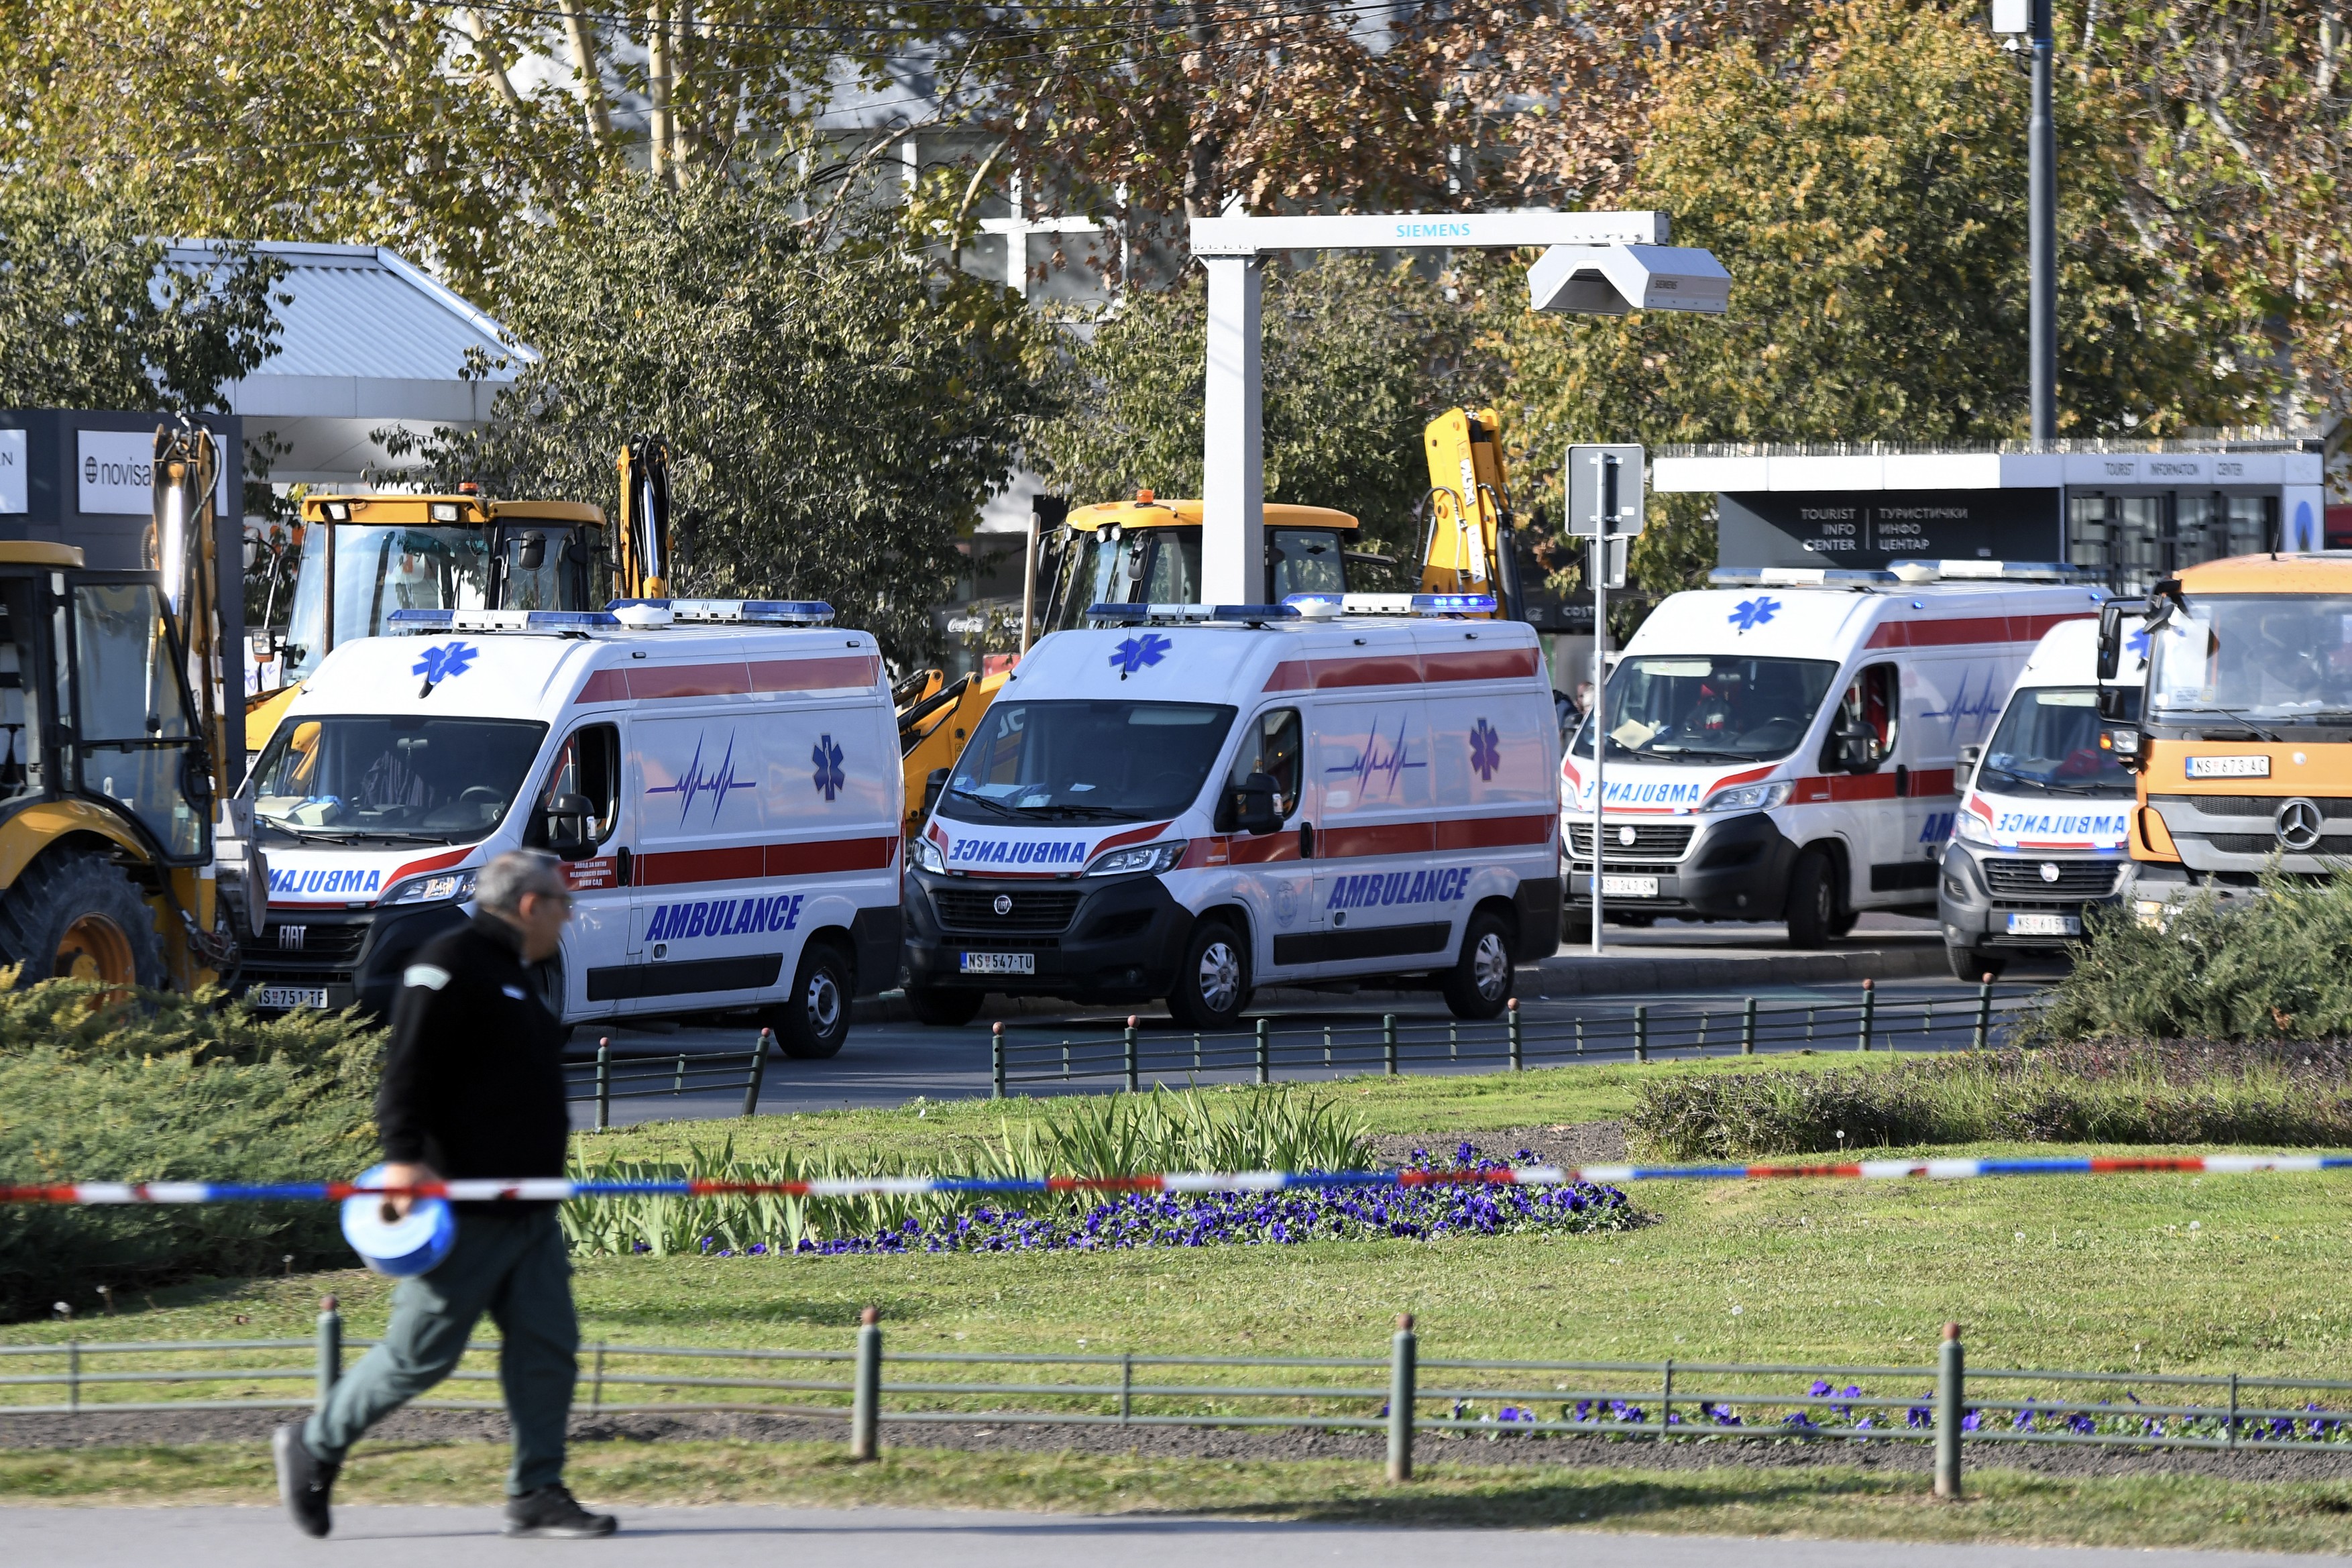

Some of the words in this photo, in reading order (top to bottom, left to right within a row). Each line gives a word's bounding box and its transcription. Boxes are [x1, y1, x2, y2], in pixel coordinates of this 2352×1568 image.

[1396, 223, 1470, 237] SIEMENS
[101, 457, 152, 486] novisa
[2105, 463, 2135, 475] TOURIST
[2150, 463, 2200, 476] INFORMATION
[2217, 463, 2245, 476] CENTER
[1801, 508, 1856, 520] TOURIST
[1879, 508, 1968, 519] ТУРИСТИЧКИ
[1822, 523, 1856, 535] INFO
[1879, 523, 1921, 535] ИНФО
[1803, 539, 1856, 551] CENTER
[1879, 539, 1930, 552] ЦЕНТАР
[1562, 606, 1595, 618] COST
[2196, 760, 2211, 773] NS
[592, 879, 602, 887] САД
[1326, 867, 1472, 910] AMBULANCE
[645, 895, 804, 941] AMBULANCE
[279, 925, 307, 949] FIAT
[968, 954, 983, 968] NS
